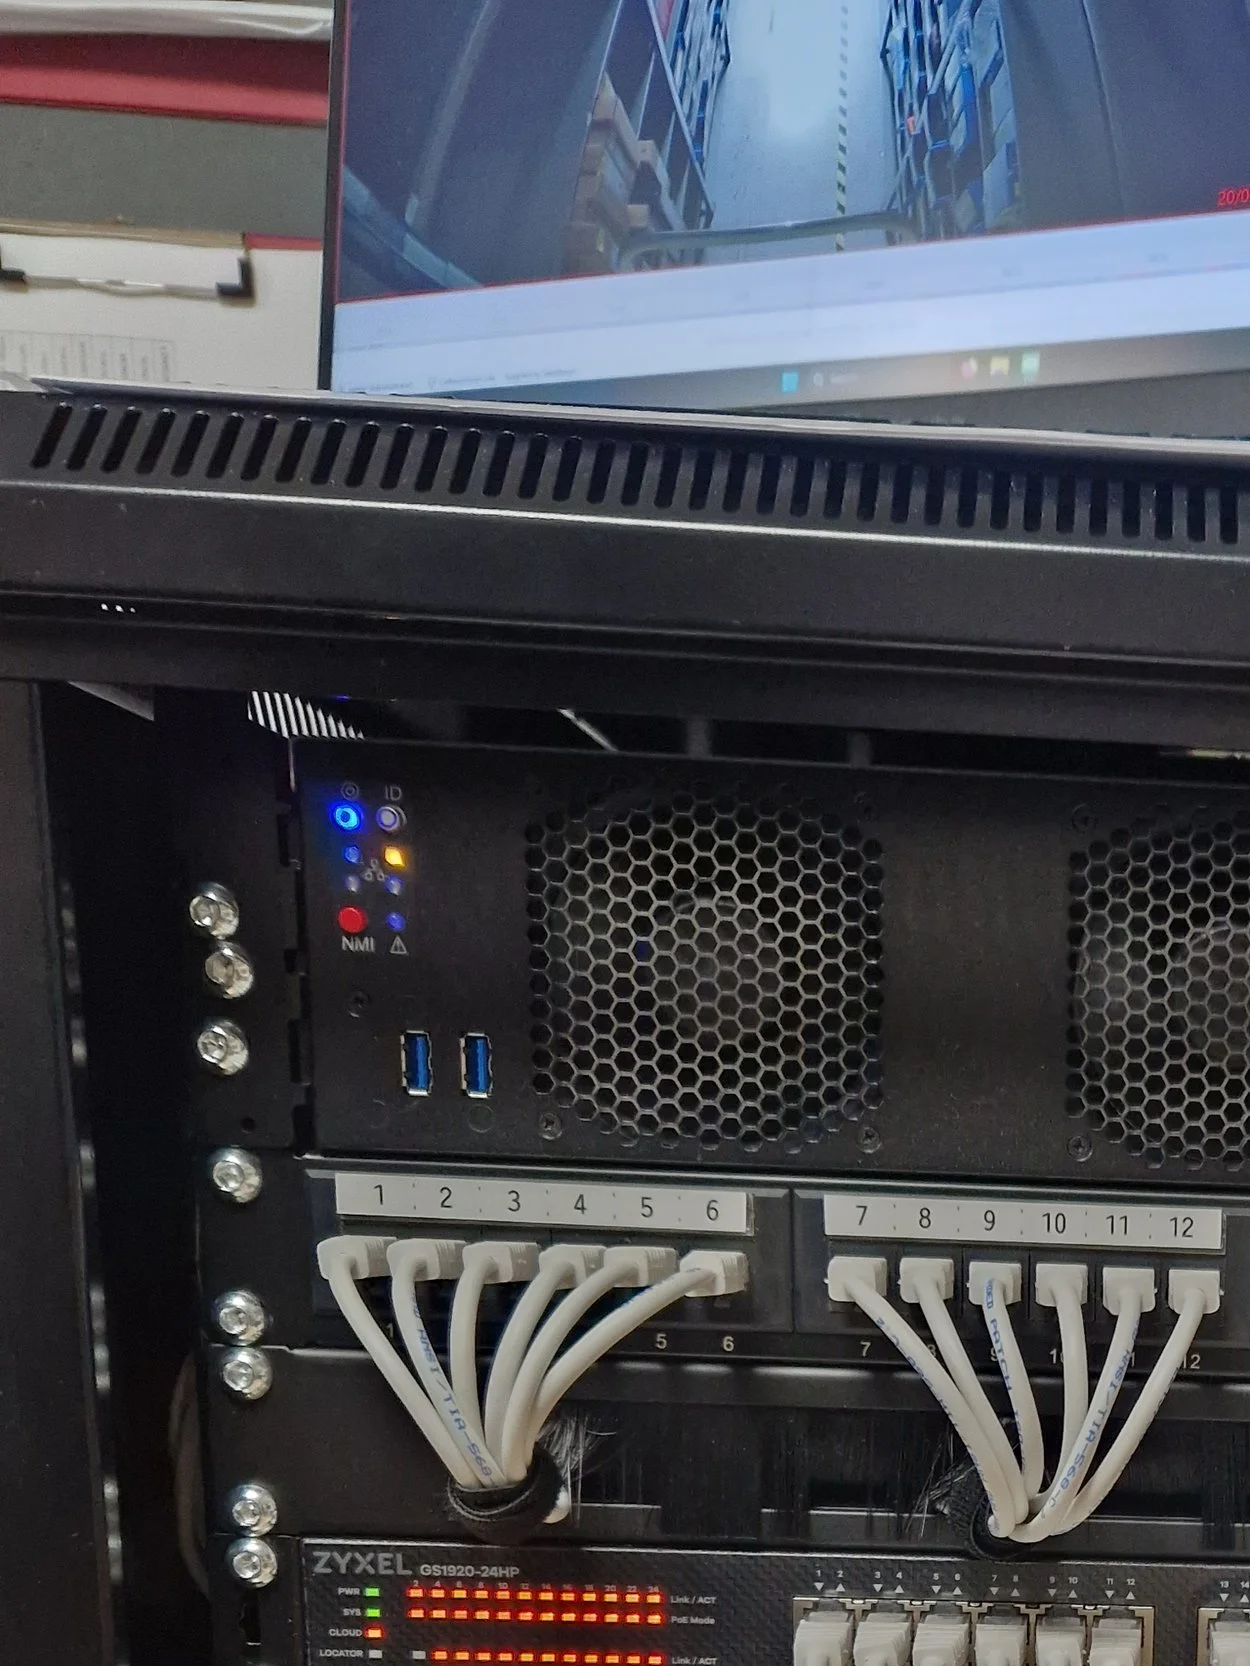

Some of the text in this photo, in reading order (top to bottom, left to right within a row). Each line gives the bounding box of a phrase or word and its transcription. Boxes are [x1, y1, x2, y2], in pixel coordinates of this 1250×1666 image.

[385, 786, 402, 800] ID
[342, 936, 376, 952] NMI
[375, 1185, 718, 1221] 1 2 3 4 5 6
[856, 1206, 1193, 1237] 7 8 9 10 11 12
[656, 1334, 734, 1351] 5 6
[861, 1342, 870, 1356] 7
[313, 1552, 519, 1578] ZYXEL GS1920-24HP
[338, 1587, 360, 1595] PWR
[671, 1596, 717, 1605] Link ACT
[343, 1608, 361, 1616] SYS
[671, 1616, 715, 1624] PoE Mode
[329, 1629, 362, 1637] CLOUD
[319, 1649, 364, 1658] LOCATOR
[672, 1657, 718, 1665] Link ACT
